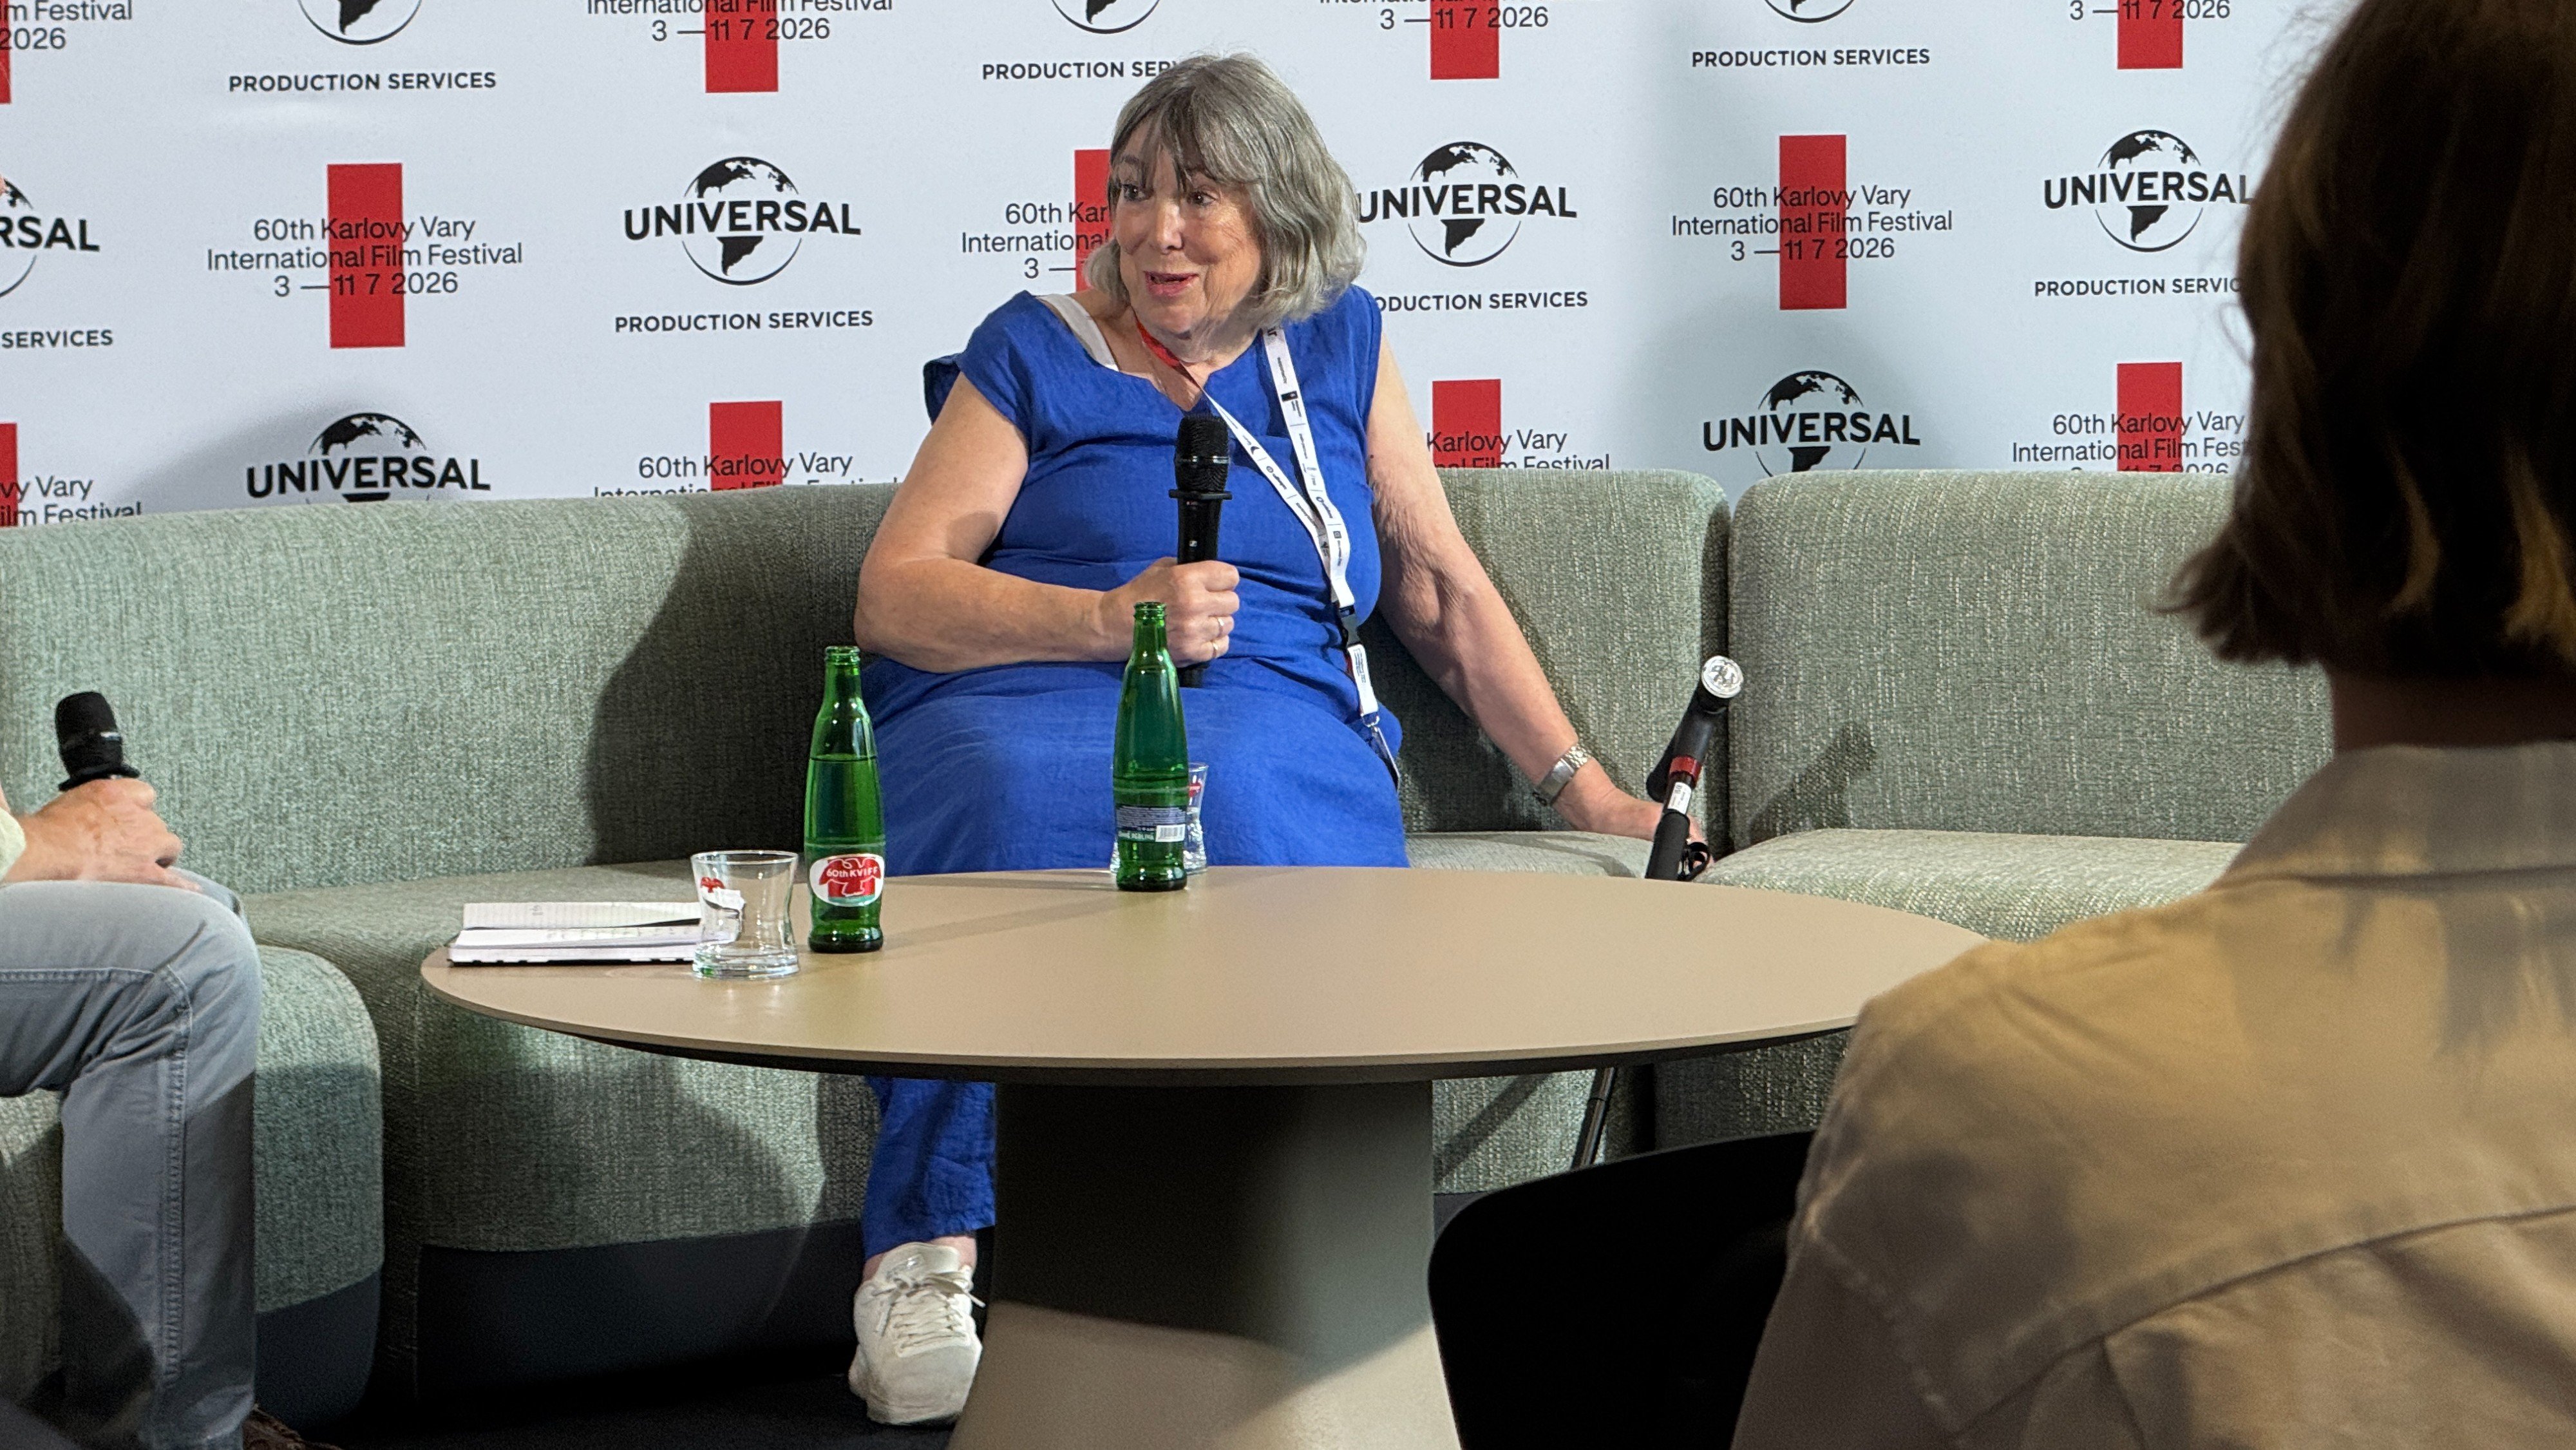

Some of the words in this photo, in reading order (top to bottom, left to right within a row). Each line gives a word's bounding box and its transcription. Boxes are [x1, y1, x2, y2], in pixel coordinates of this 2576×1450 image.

[1380, 8, 1394, 30] 3
[1464, 7, 1477, 28] 7
[1488, 6, 1548, 29] 2026
[2070, 0, 2083, 21] 3
[2150, 0, 2163, 19] 7
[2172, 0, 2230, 20] 2026
[652, 19, 667, 42] 3
[740, 19, 755, 40] 7
[765, 17, 830, 41] 2026
[982, 61, 1124, 80] PRODUCTION
[1692, 50, 1826, 68] PRODUCTION
[1833, 48, 1930, 66] SERVICES
[229, 73, 380, 92] PRODUCTION
[388, 72, 497, 90] SERVICES
[1713, 187, 1767, 209] 60th
[1773, 186, 1857, 210] Karlovy
[1861, 184, 1911, 209] Vary
[2044, 171, 2254, 209] UNIVERSAL
[1005, 202, 1062, 225] 60th
[1357, 184, 1577, 224] UNIVERSAL
[254, 218, 314, 241] 60th
[321, 217, 415, 242] Karlovy
[420, 216, 476, 242] Vary
[624, 200, 861, 241] UNIVERSAL
[1672, 213, 1813, 236] International
[1817, 213, 1862, 234] Film
[1868, 210, 1952, 232] Festival
[207, 245, 365, 270] International
[371, 244, 421, 267] Film
[428, 242, 522, 265] Festival
[1730, 240, 1745, 262] 3
[1811, 238, 1826, 260] 7
[1835, 238, 1895, 261] 2026
[1024, 257, 1039, 279] 3
[274, 275, 290, 298] 3
[365, 273, 381, 295] 7
[391, 271, 458, 296] 2026
[2034, 278, 2165, 297] PRODUCTION
[1489, 291, 1588, 309] SERVICES
[615, 313, 761, 333] PRODUCTION
[768, 310, 873, 329] SERVICES
[1, 329, 113, 349] SERVICES
[1703, 412, 1920, 452] UNIVERSAL
[2053, 414, 2105, 435] 60th
[2111, 412, 2192, 435] Karlovy
[2196, 410, 2246, 435] Vary
[1426, 430, 1512, 455] Karlovy
[1516, 429, 1567, 453] Vary
[2013, 439, 2148, 463] International
[2154, 437, 2197, 459] Film
[246, 457, 491, 499] UNIVERSAL
[639, 456, 697, 479] 60th
[704, 454, 794, 478] Karlovy
[799, 452, 853, 477] Vary
[35, 475, 93, 501] Vary
[826, 868, 849, 878] 60th
